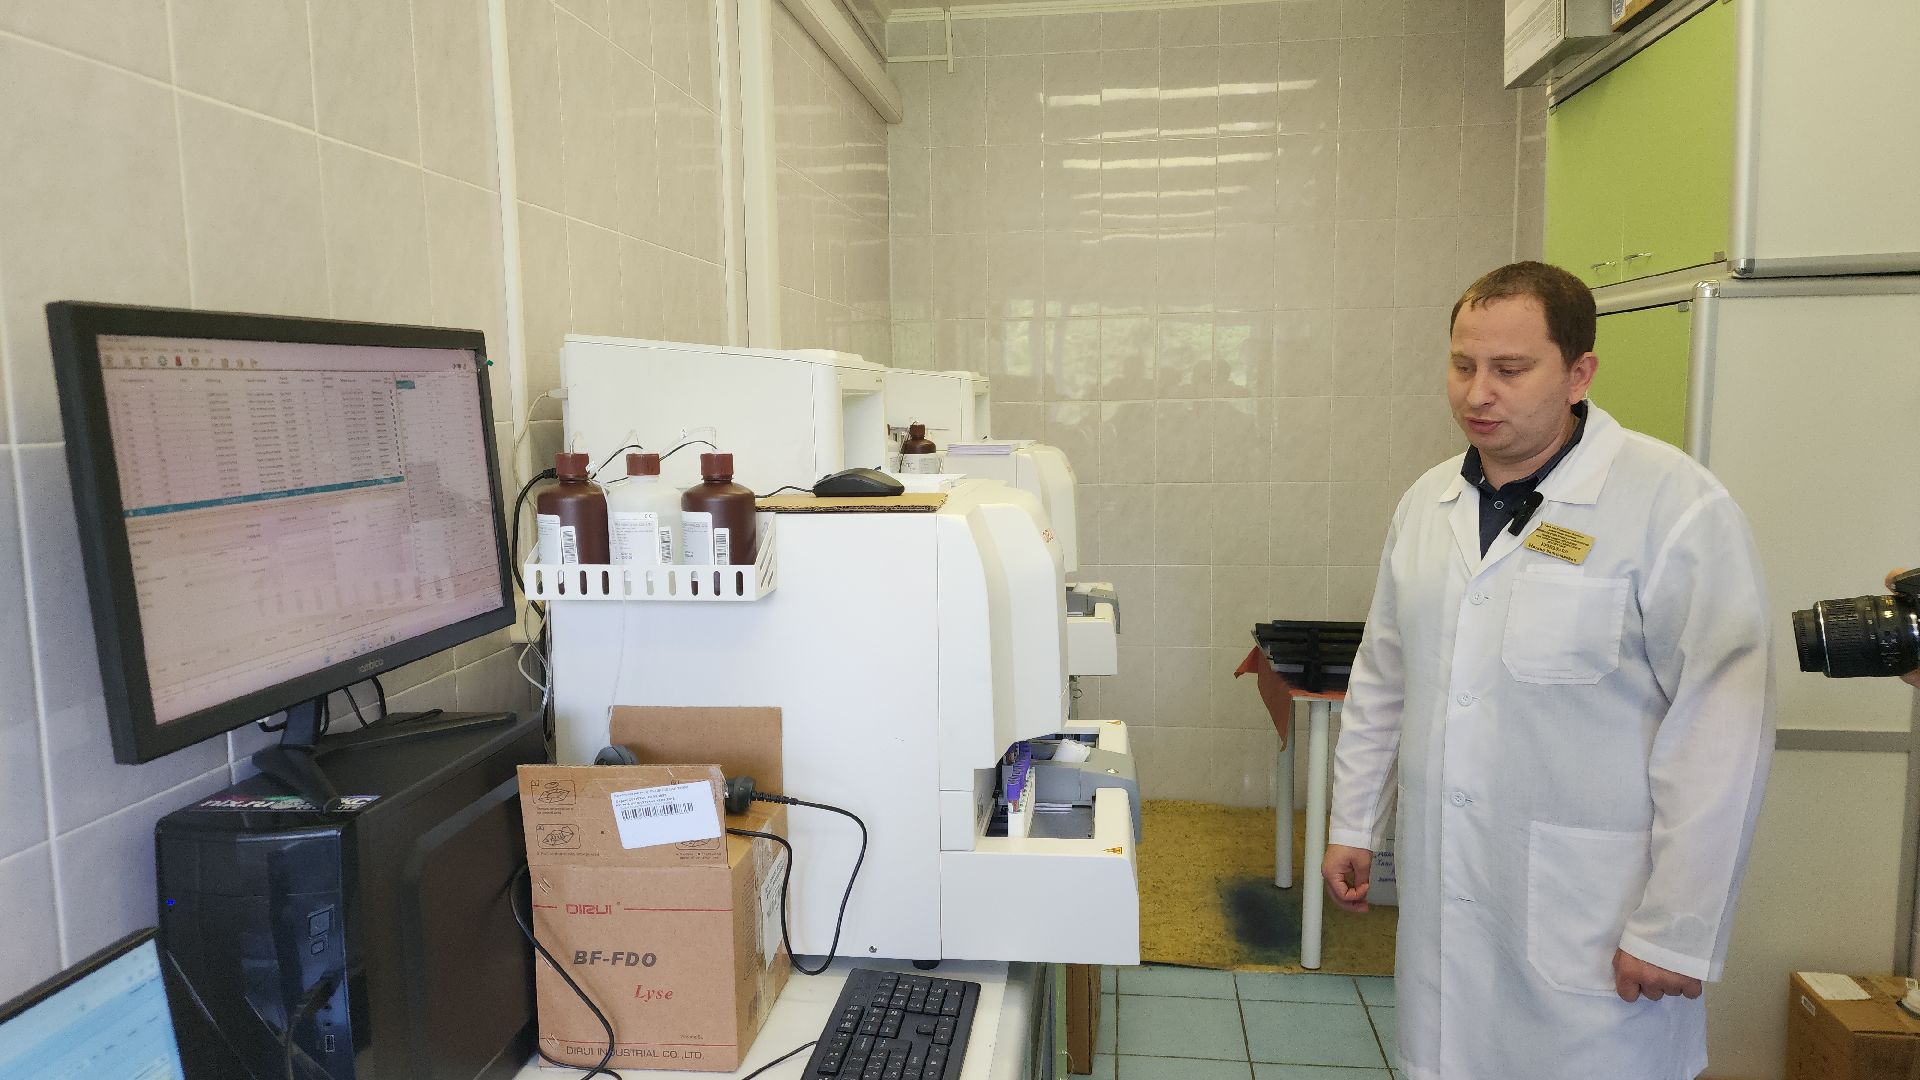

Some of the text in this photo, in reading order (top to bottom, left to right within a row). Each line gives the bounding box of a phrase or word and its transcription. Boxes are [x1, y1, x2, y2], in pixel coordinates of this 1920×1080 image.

[566, 904, 612, 915] DIRUI
[573, 950, 657, 968] BF-FDO
[634, 984, 673, 1002] Lyse
[566, 1046, 593, 1056] DIRUI
